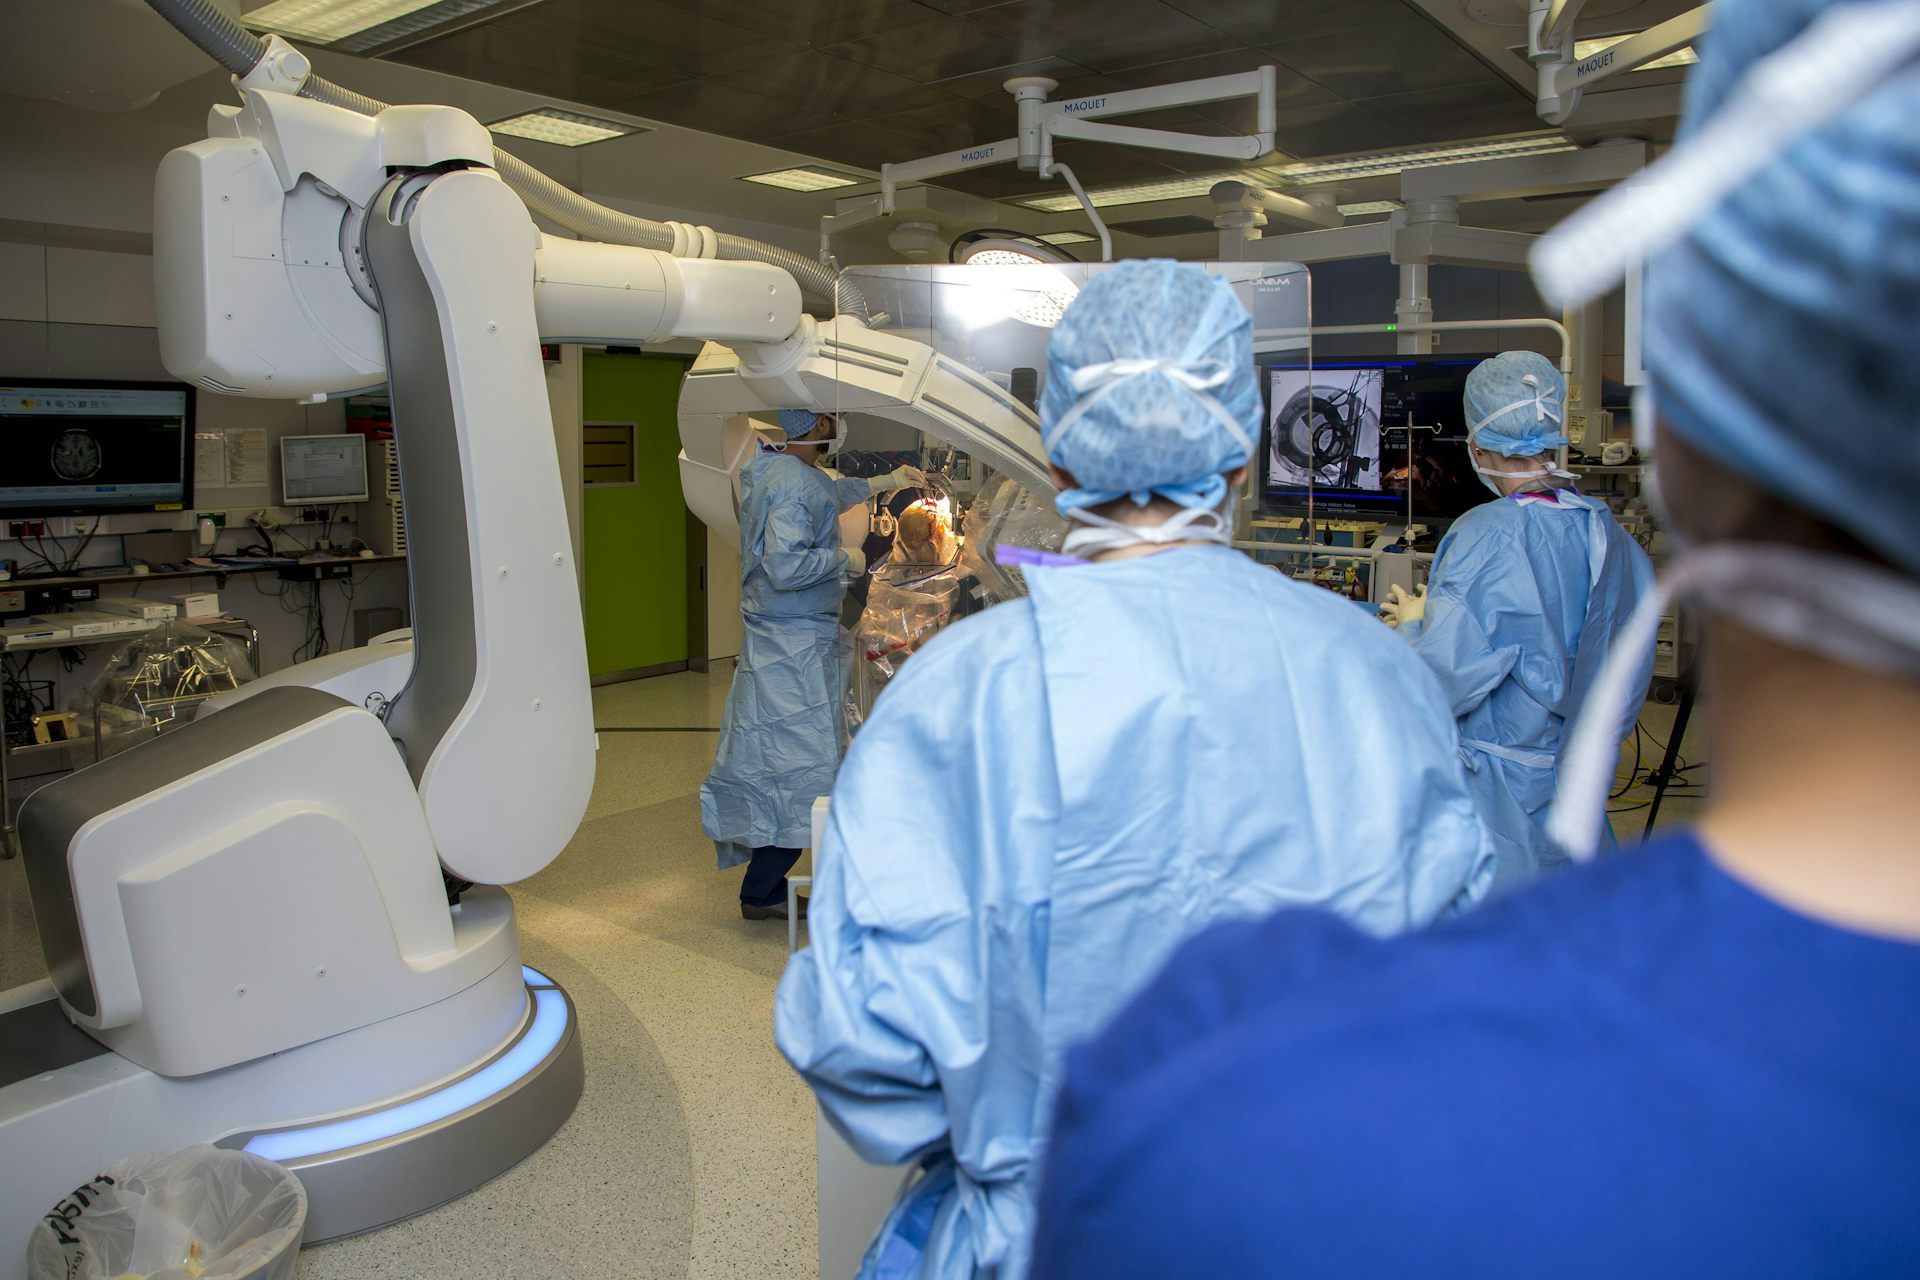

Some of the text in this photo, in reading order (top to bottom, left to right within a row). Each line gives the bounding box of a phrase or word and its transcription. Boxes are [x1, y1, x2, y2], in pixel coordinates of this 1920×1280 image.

[1577, 51, 1615, 78] MAQUET
[1064, 97, 1107, 113] MAQUET
[961, 147, 994, 163] MAQUET
